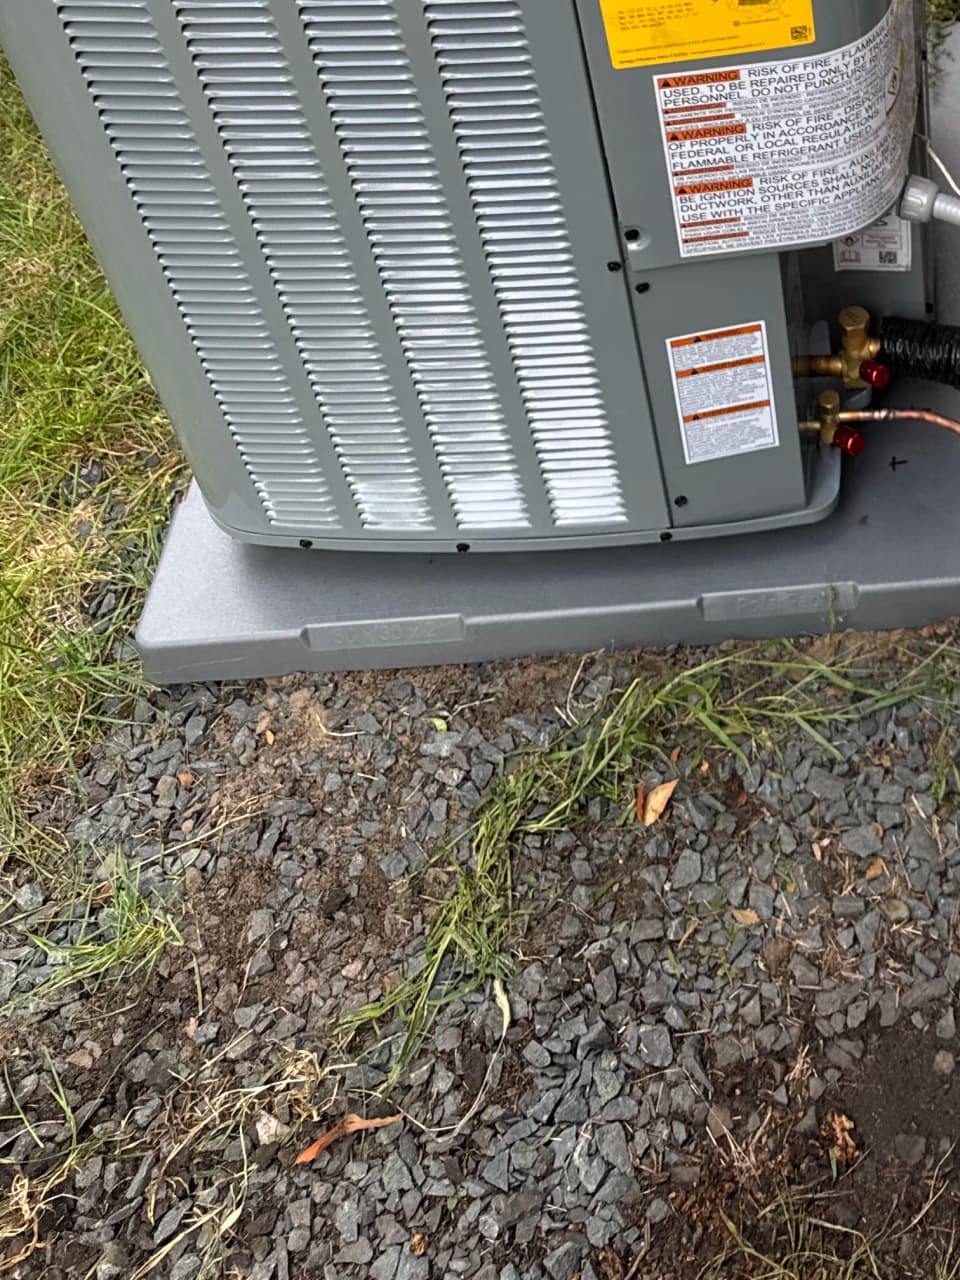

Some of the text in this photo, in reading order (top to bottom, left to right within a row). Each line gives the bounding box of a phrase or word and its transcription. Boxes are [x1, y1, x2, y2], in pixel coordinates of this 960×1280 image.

[674, 72, 738, 86] WARNING
[748, 67, 778, 77] RISK
[781, 63, 800, 74] OF
[803, 59, 832, 70] FIRE
[707, 83, 726, 94] TO
[728, 81, 747, 91] BE
[751, 73, 816, 87] REPAIRED
[819, 62, 852, 77] ONLY
[751, 87, 771, 97] DO
[774, 83, 801, 94] NOT
[804, 64, 867, 89] PUNCTURE
[668, 142, 687, 151] OF
[691, 134, 760, 148] PROPERLY
[763, 131, 775, 140] IN
[778, 113, 864, 137] ACCORDANCE
[683, 126, 745, 138] WARNING
[753, 121, 785, 131] RISK
[785, 118, 803, 127] OF
[806, 113, 834, 124] FIRE
[673, 155, 749, 169] FLAMMABLE
[753, 140, 841, 159] REFRIGERANT
[735, 143, 754, 153] OR
[758, 138, 798, 149] LOCAL
[679, 195, 696, 204] BE
[700, 189, 755, 200] IGNITION
[759, 181, 819, 194] SOURCES
[822, 170, 858, 184] SHALL
[692, 180, 751, 192] WARNING
[759, 174, 790, 185] RISK
[791, 171, 809, 181] OF
[813, 167, 840, 177] FIRE
[761, 191, 804, 202] OTHER
[808, 185, 840, 196] THAN
[681, 212, 708, 222] USE
[709, 207, 743, 218] WITH
[747, 204, 771, 214] THE
[775, 198, 831, 211] SPECIFIC
